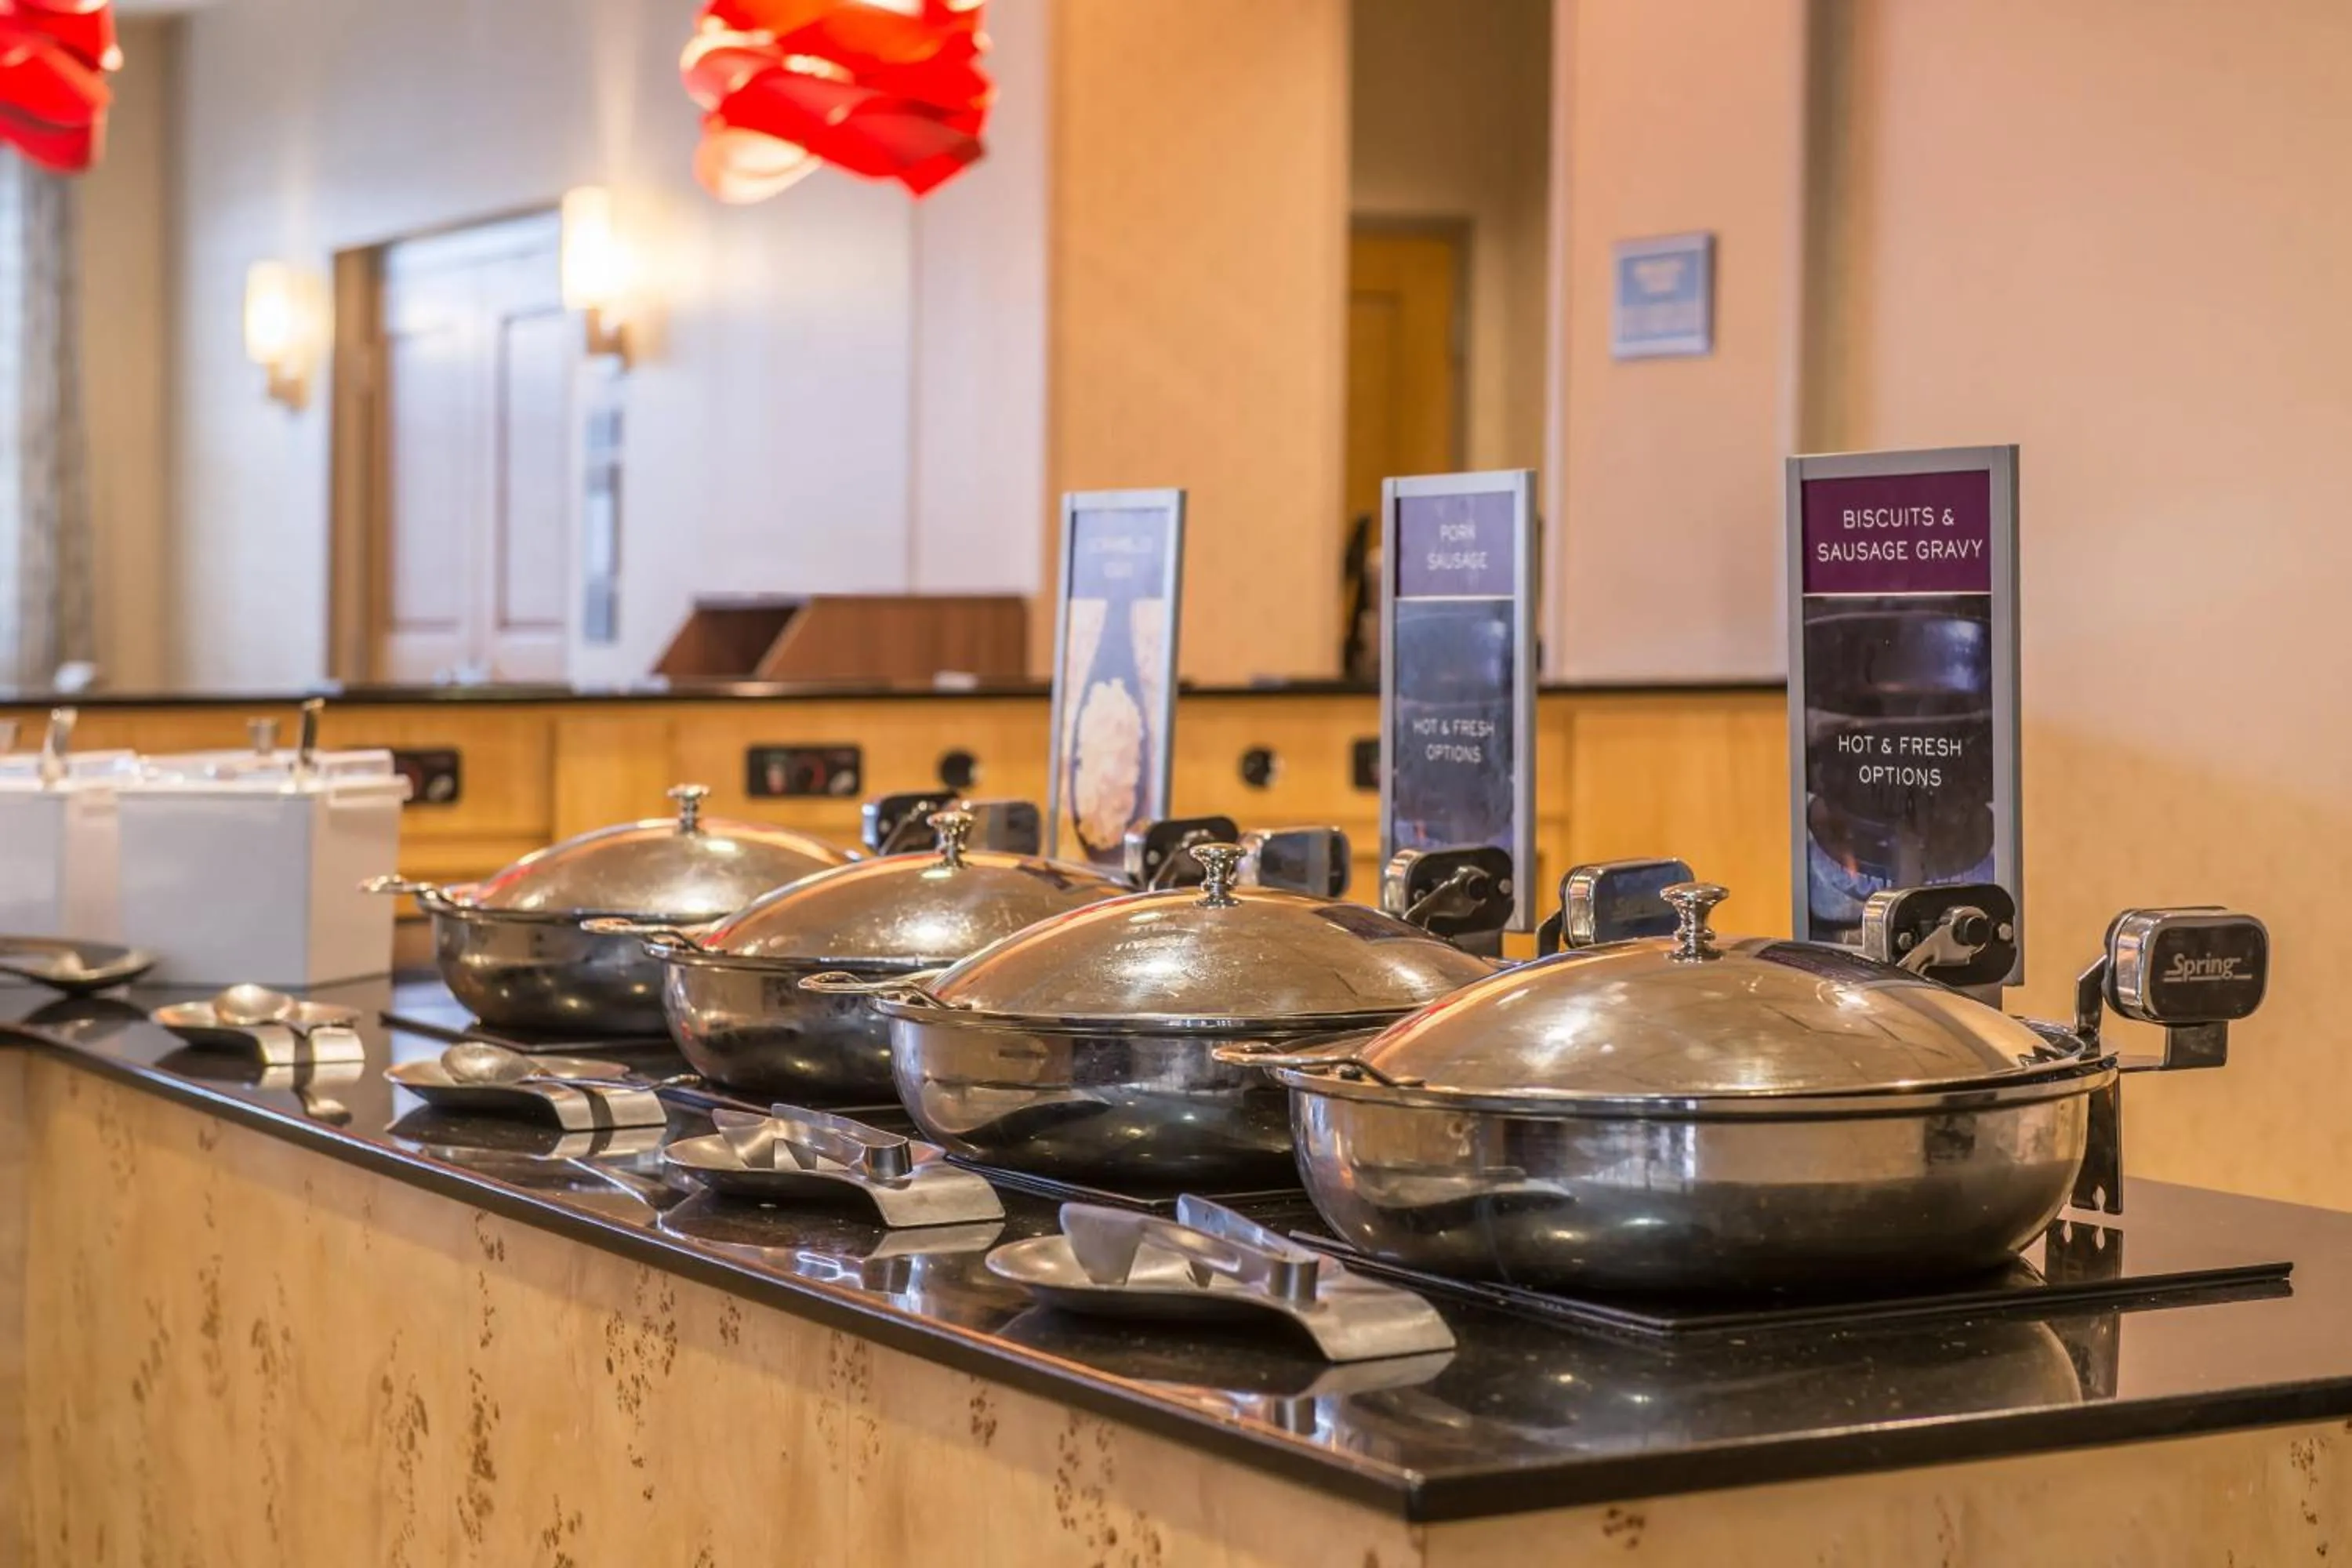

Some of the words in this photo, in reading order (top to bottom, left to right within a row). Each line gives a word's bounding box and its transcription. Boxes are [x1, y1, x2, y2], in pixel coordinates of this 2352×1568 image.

[1843, 506, 1934, 529] BISCUITS
[1941, 508, 1955, 526] &
[1817, 540, 1908, 562] SAUSAGE
[1915, 539, 1983, 560] GRAVY
[1413, 717, 1438, 735] HOT
[1453, 719, 1495, 738] FRESH
[1425, 743, 1483, 764] OPTIONS
[1838, 735, 1875, 753] HOT
[1881, 738, 1892, 754] &
[1900, 736, 1962, 757] FRESH
[1858, 765, 1942, 787] OPTIONS
[2163, 953, 2243, 982] Spring
